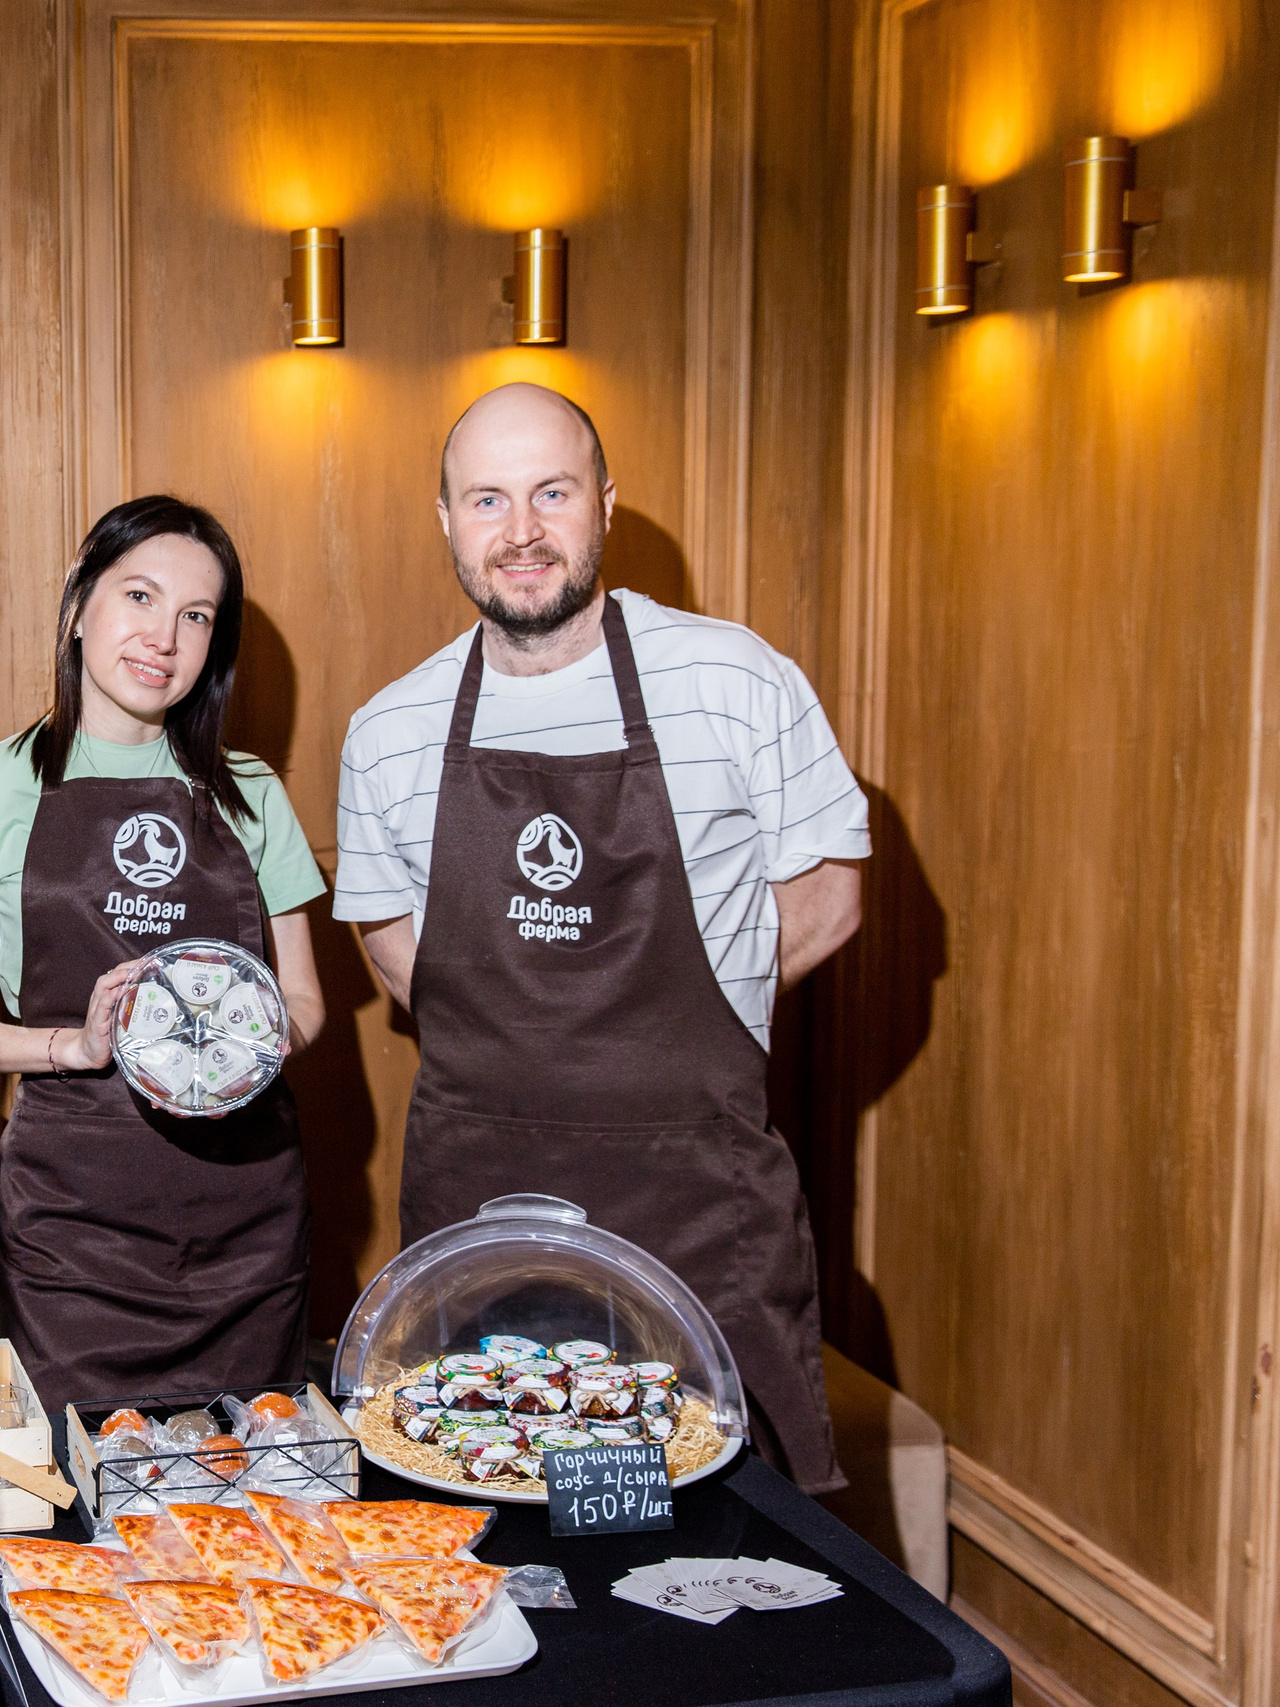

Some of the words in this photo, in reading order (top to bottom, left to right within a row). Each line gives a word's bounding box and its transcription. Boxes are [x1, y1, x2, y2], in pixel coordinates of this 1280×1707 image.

[103, 891, 186, 921] Добрая
[506, 895, 593, 926] Добрая
[114, 915, 172, 936] ферма
[518, 920, 581, 943] ферма
[554, 1446, 662, 1477] Горчичный
